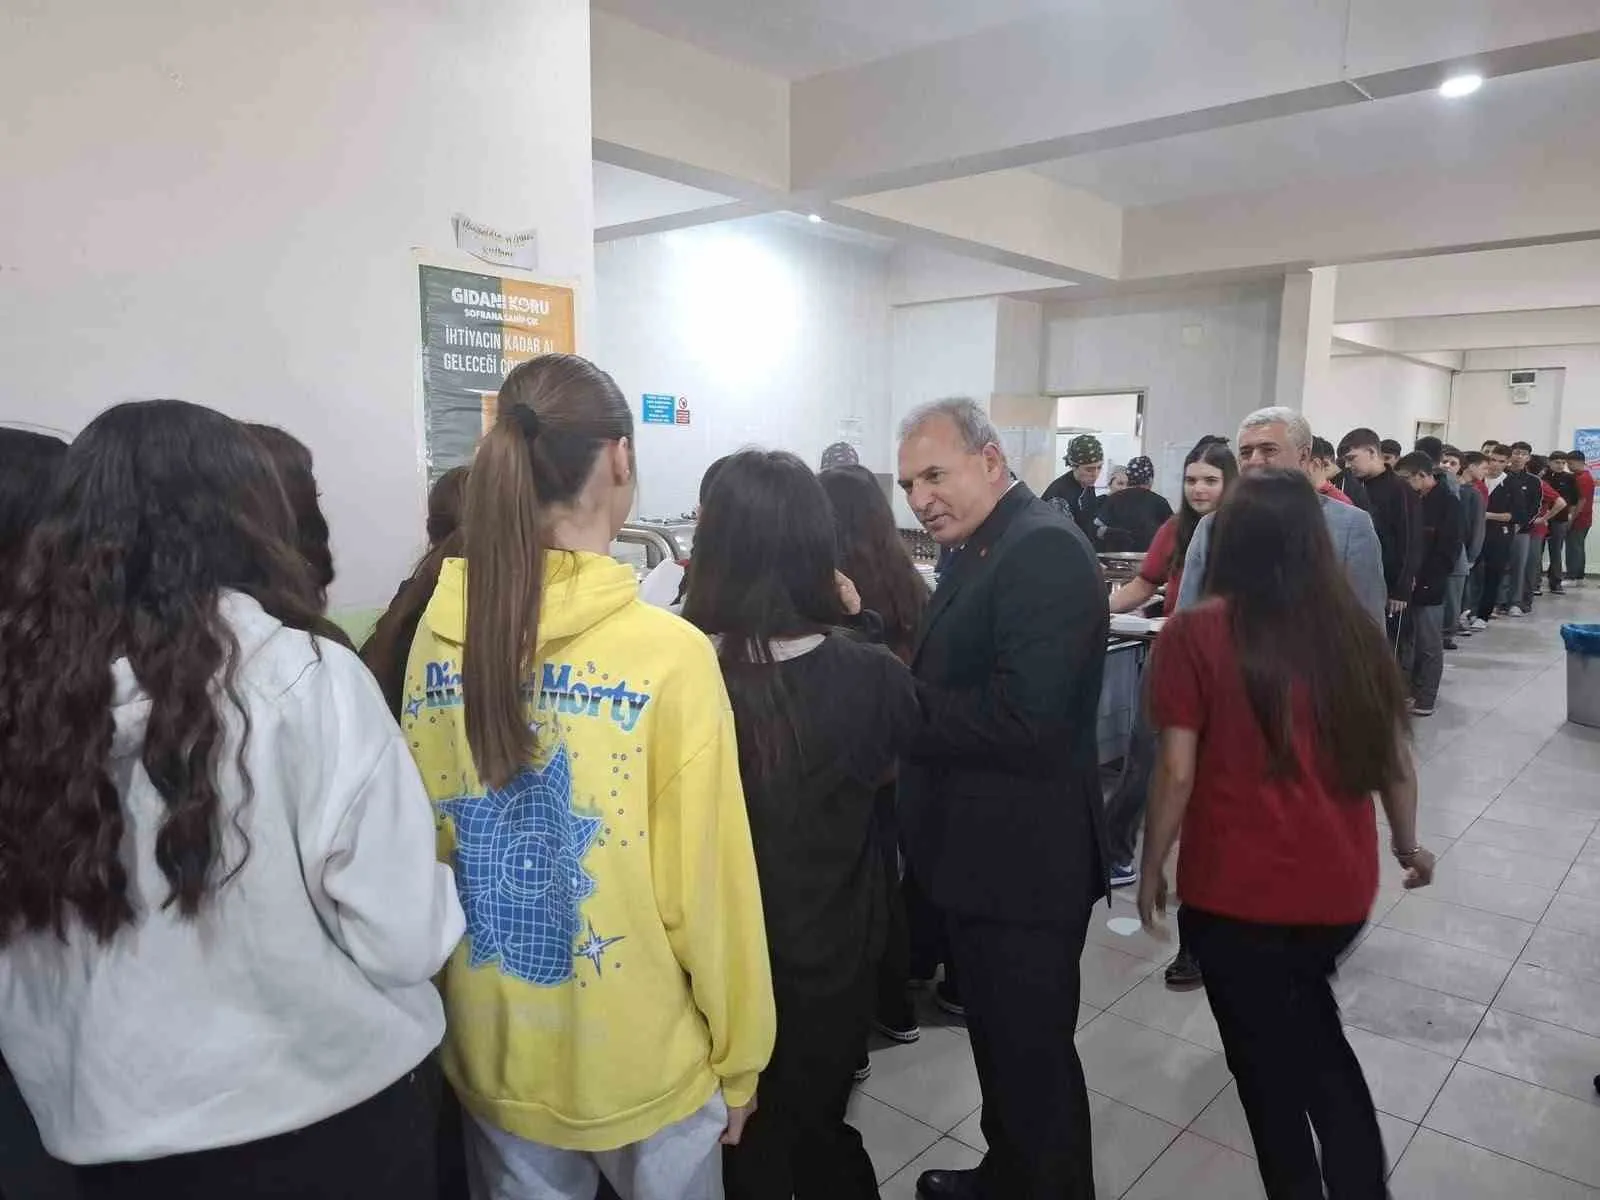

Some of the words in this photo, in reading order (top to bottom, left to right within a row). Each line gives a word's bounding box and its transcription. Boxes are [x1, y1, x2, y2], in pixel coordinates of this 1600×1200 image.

[508, 295, 550, 315] KORU
[445, 325, 501, 349] İHTİYACIN
[504, 333, 540, 353] KADAR
[443, 353, 497, 374] GELECEĞİ
[426, 661, 463, 707] Ric
[536, 662, 650, 731] Morty
